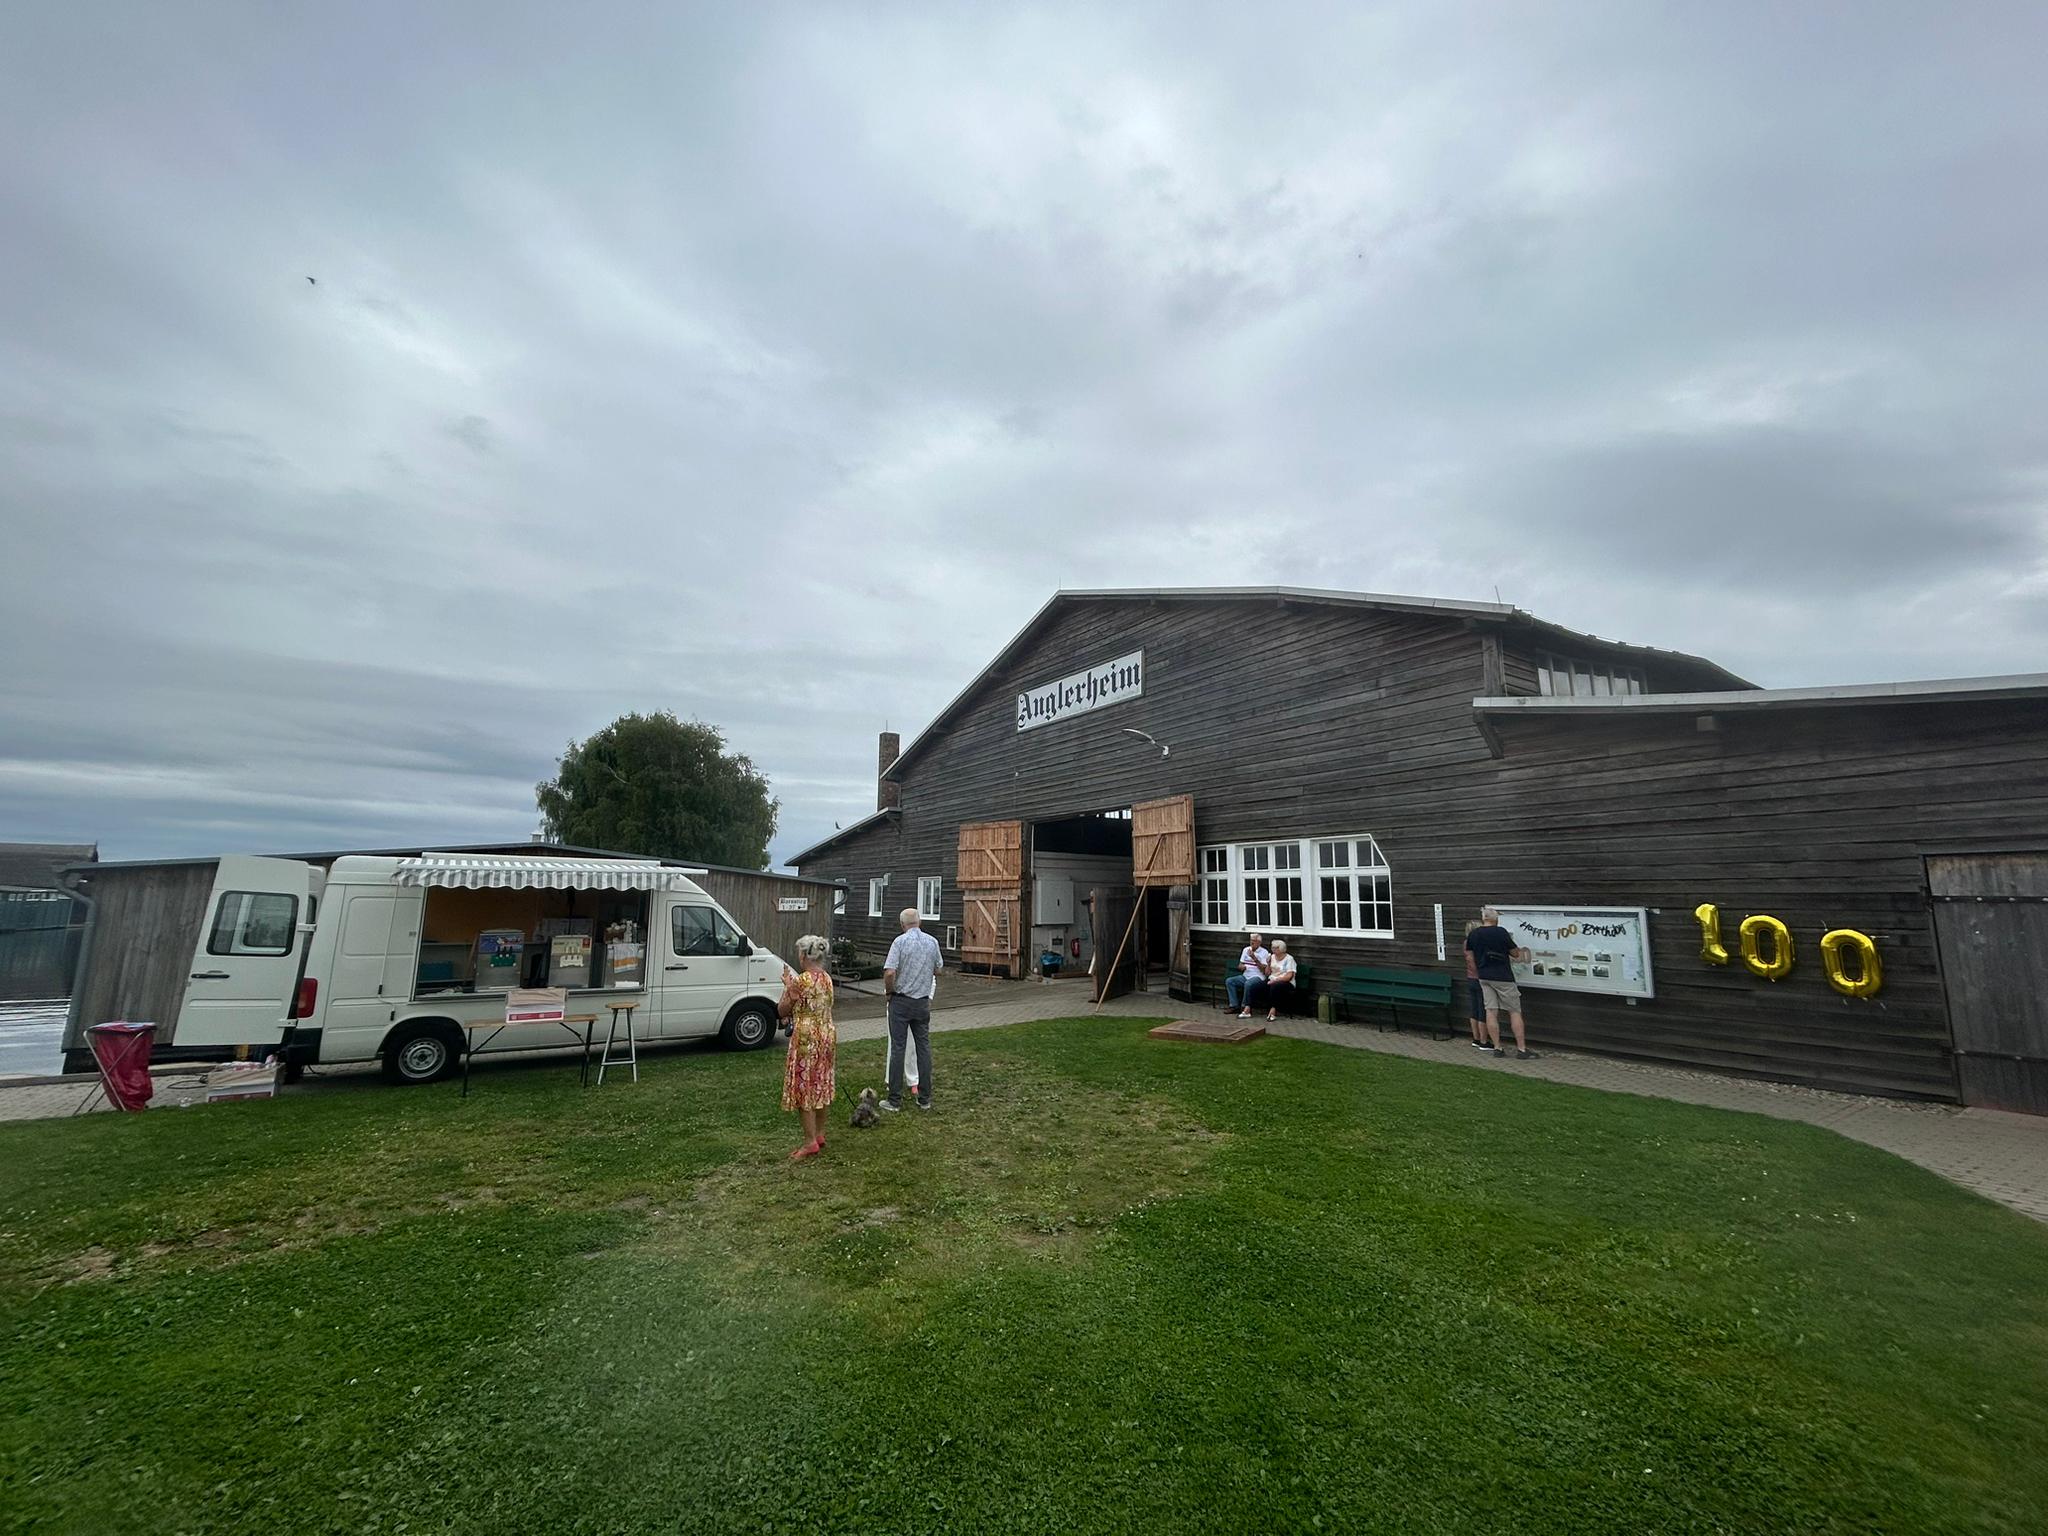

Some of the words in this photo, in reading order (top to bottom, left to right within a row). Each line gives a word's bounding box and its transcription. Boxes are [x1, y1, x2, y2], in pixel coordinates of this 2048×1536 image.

[1018, 663, 1140, 728] Anglerheim
[1519, 921, 1550, 940] Happy
[1556, 923, 1578, 940] 100
[1581, 922, 1627, 938] Birthday
